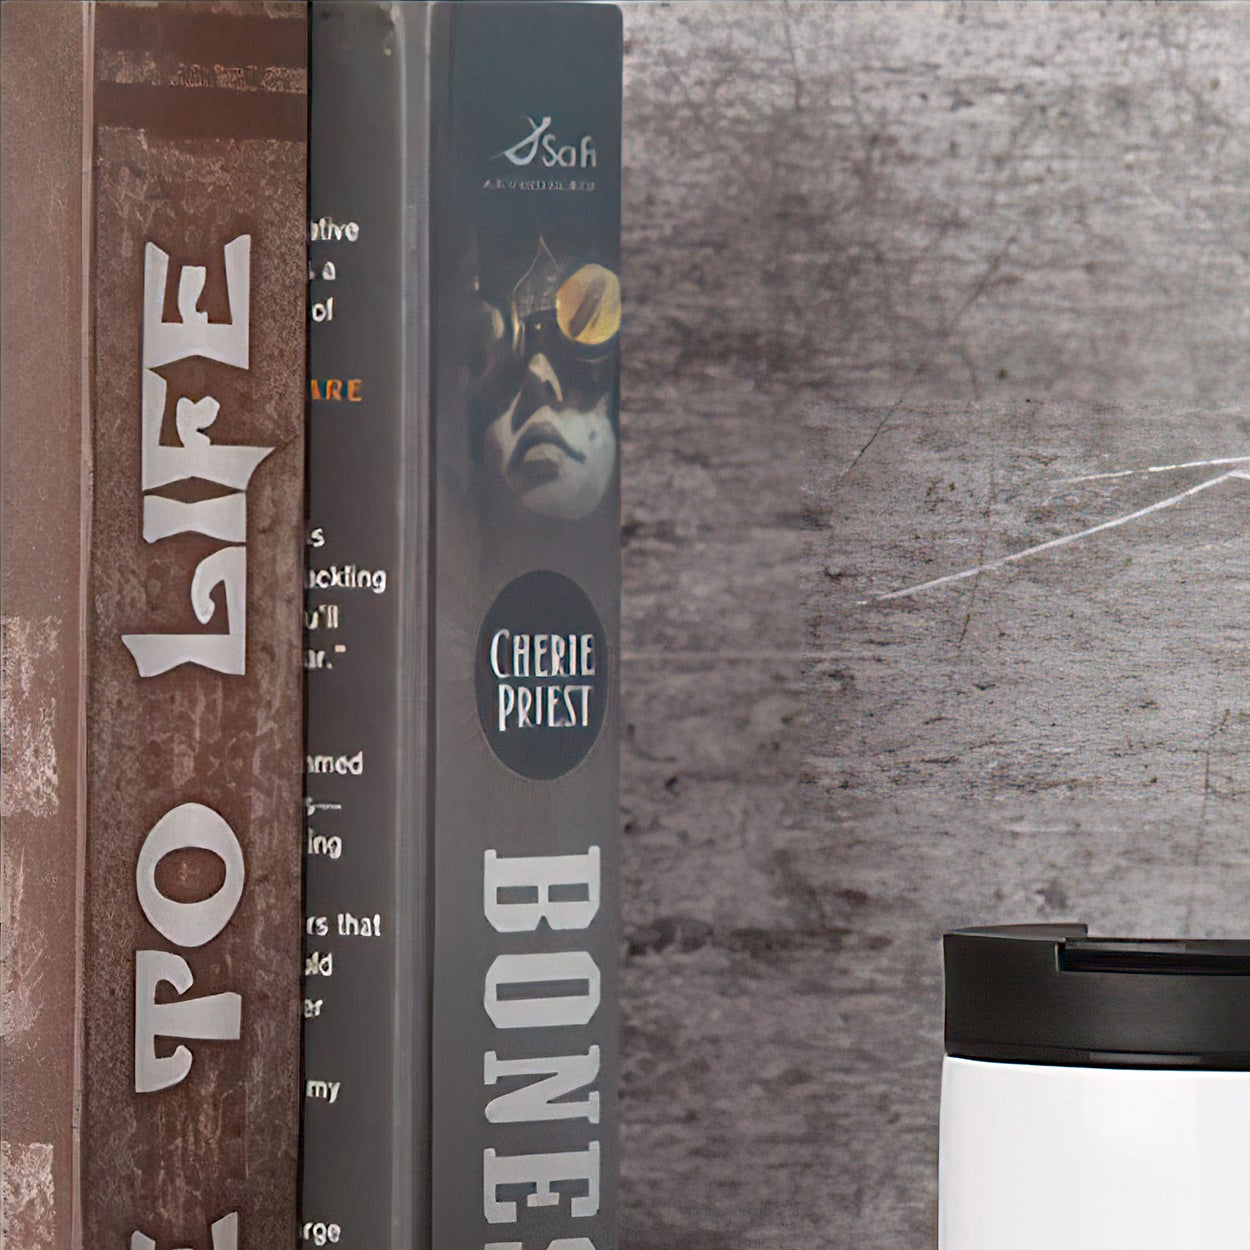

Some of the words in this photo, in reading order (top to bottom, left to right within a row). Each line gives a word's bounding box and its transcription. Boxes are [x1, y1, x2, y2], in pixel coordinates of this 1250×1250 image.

[121, 234, 276, 677] LIFE
[490, 628, 596, 679] CHERIE
[498, 683, 593, 732] PRIEST
[135, 802, 245, 1093] TO
